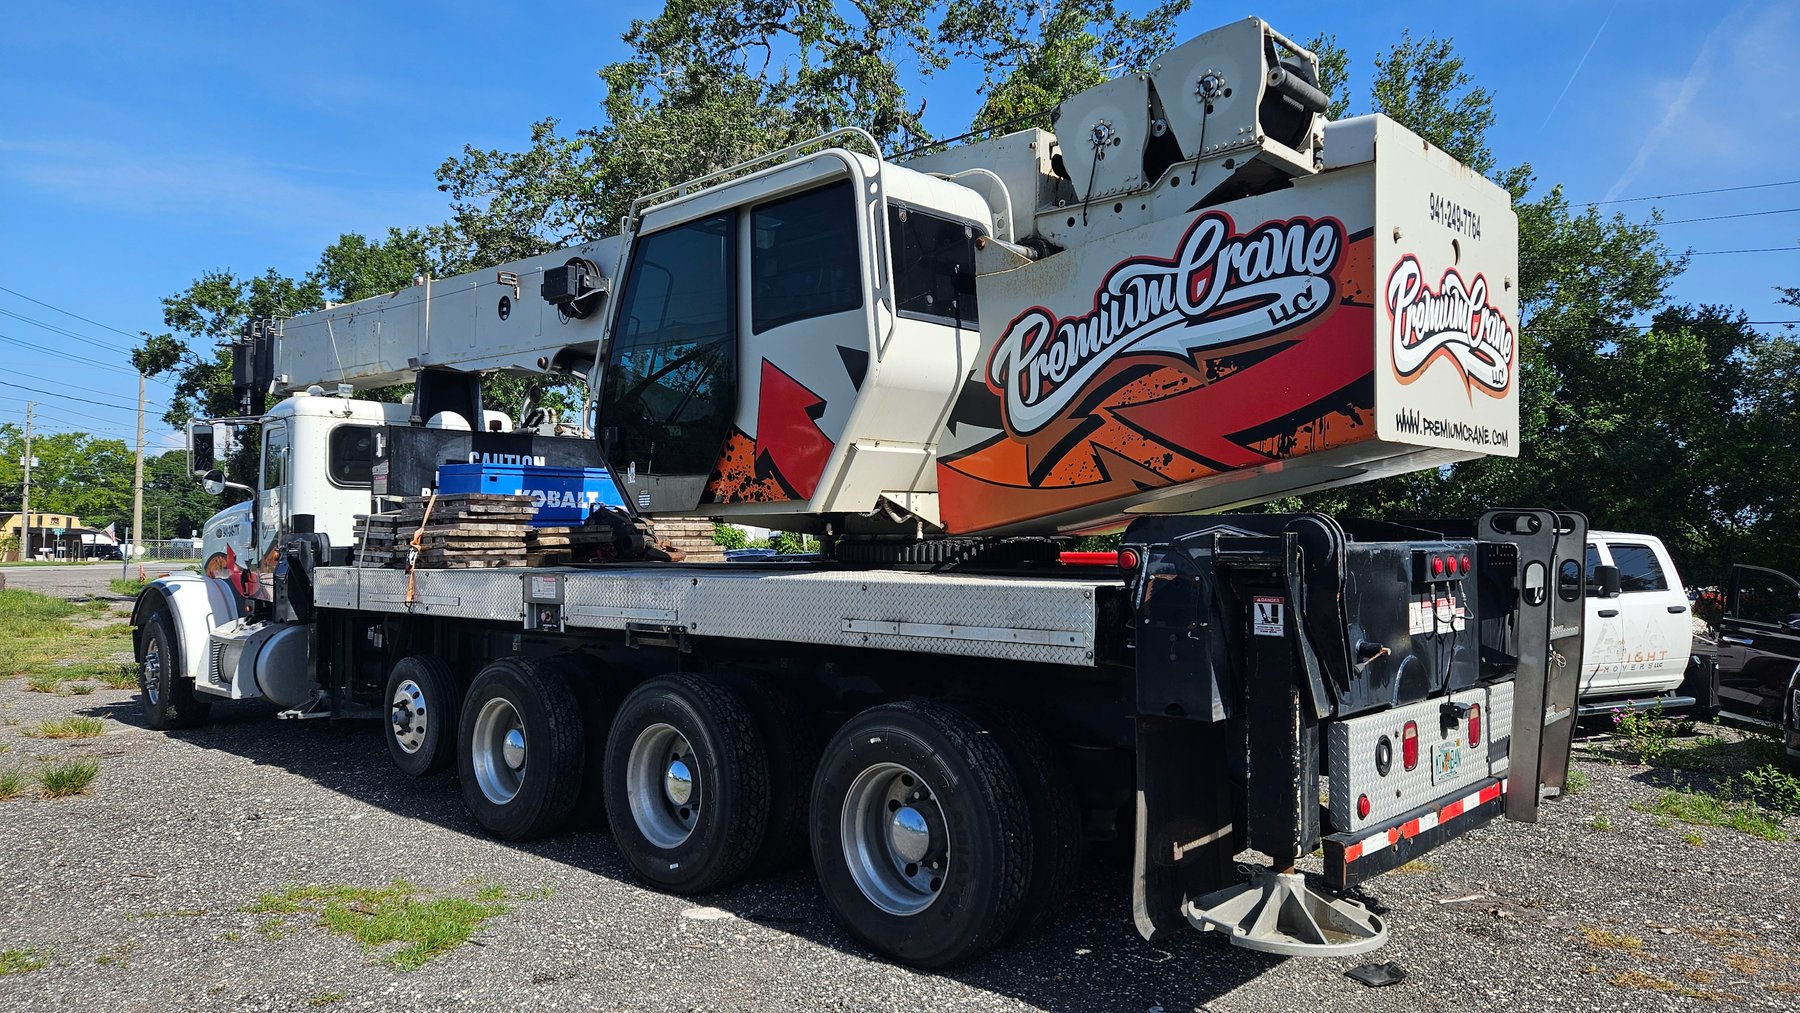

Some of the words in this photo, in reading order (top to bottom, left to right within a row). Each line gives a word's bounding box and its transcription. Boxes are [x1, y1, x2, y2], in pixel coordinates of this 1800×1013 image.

[1430, 192, 1480, 241] 941-249-7764
[990, 275, 1176, 420] Premium
[1170, 218, 1337, 315] Crane
[1267, 284, 1318, 326] LLC
[1388, 259, 1467, 352] Premium
[1464, 275, 1512, 363] Crane
[1491, 368, 1504, 385] LLC
[469, 452, 546, 467] CAUTION
[1603, 662, 1653, 672] MOVERS
